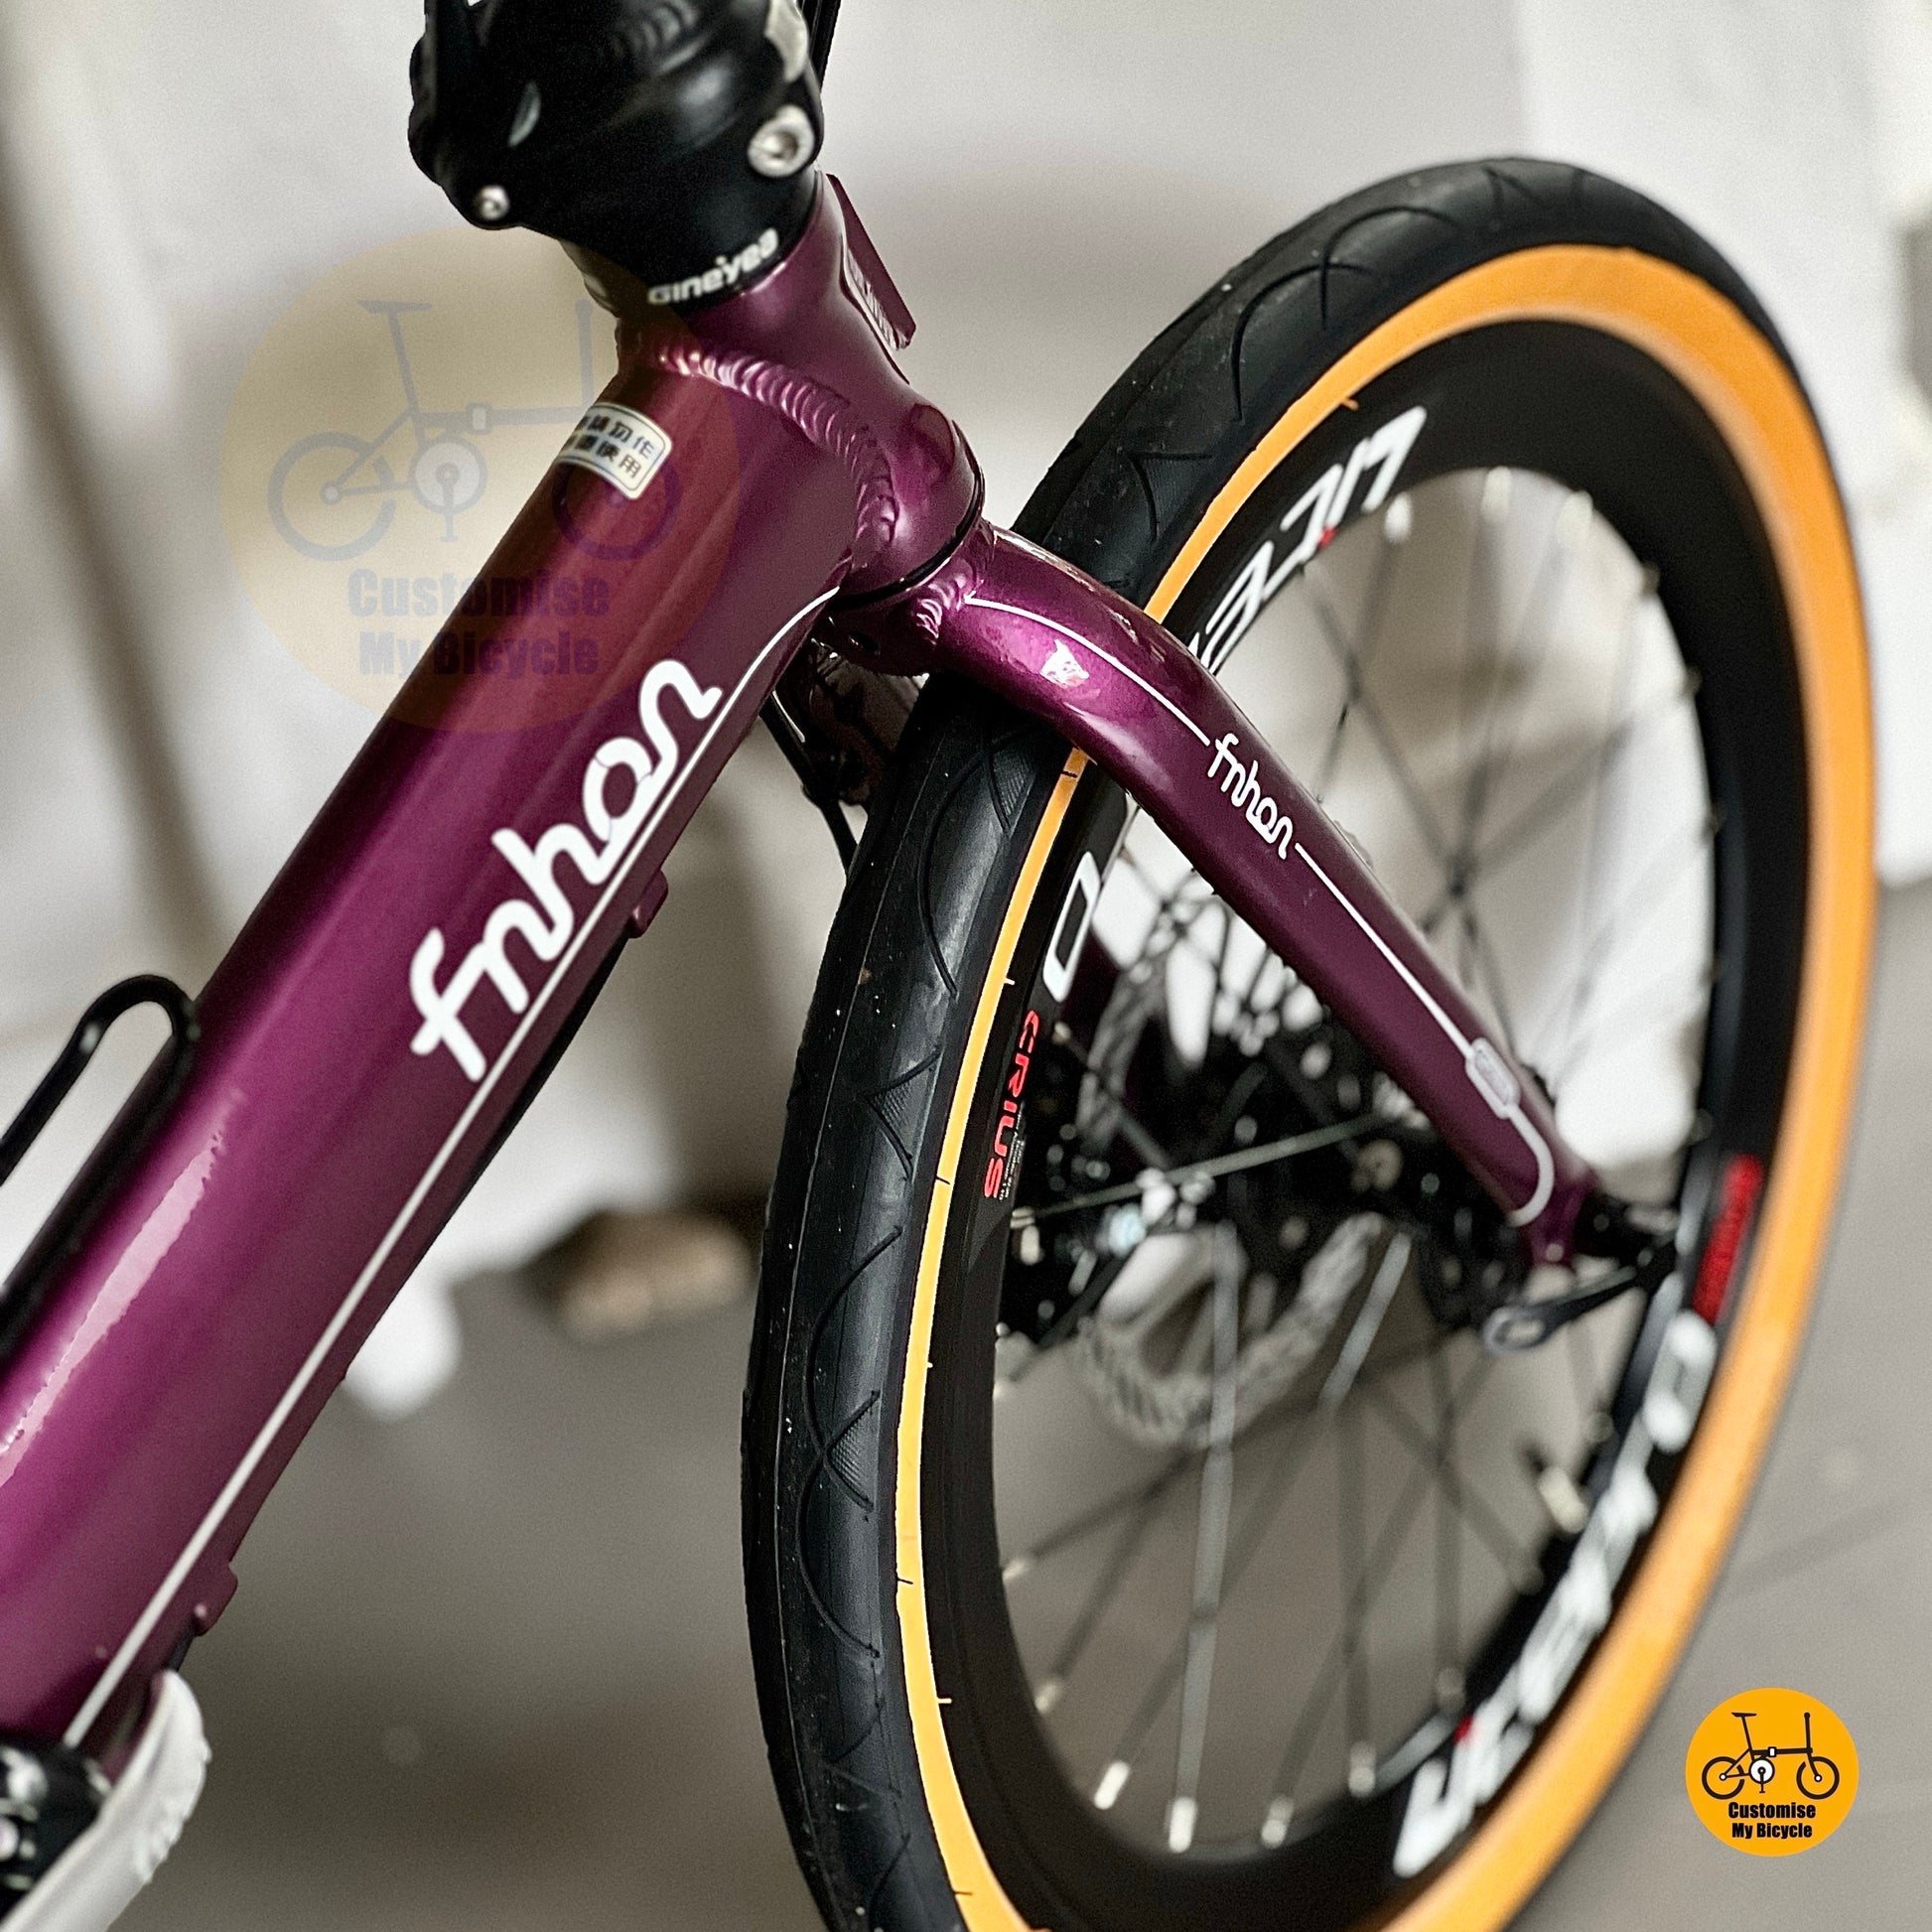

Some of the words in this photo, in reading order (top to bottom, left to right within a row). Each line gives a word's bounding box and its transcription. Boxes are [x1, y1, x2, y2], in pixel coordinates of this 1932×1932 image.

[409, 659, 723, 1082] fnhon
[1207, 733, 1293, 860] fnhon
[984, 1010, 1039, 1198] CRIUS
